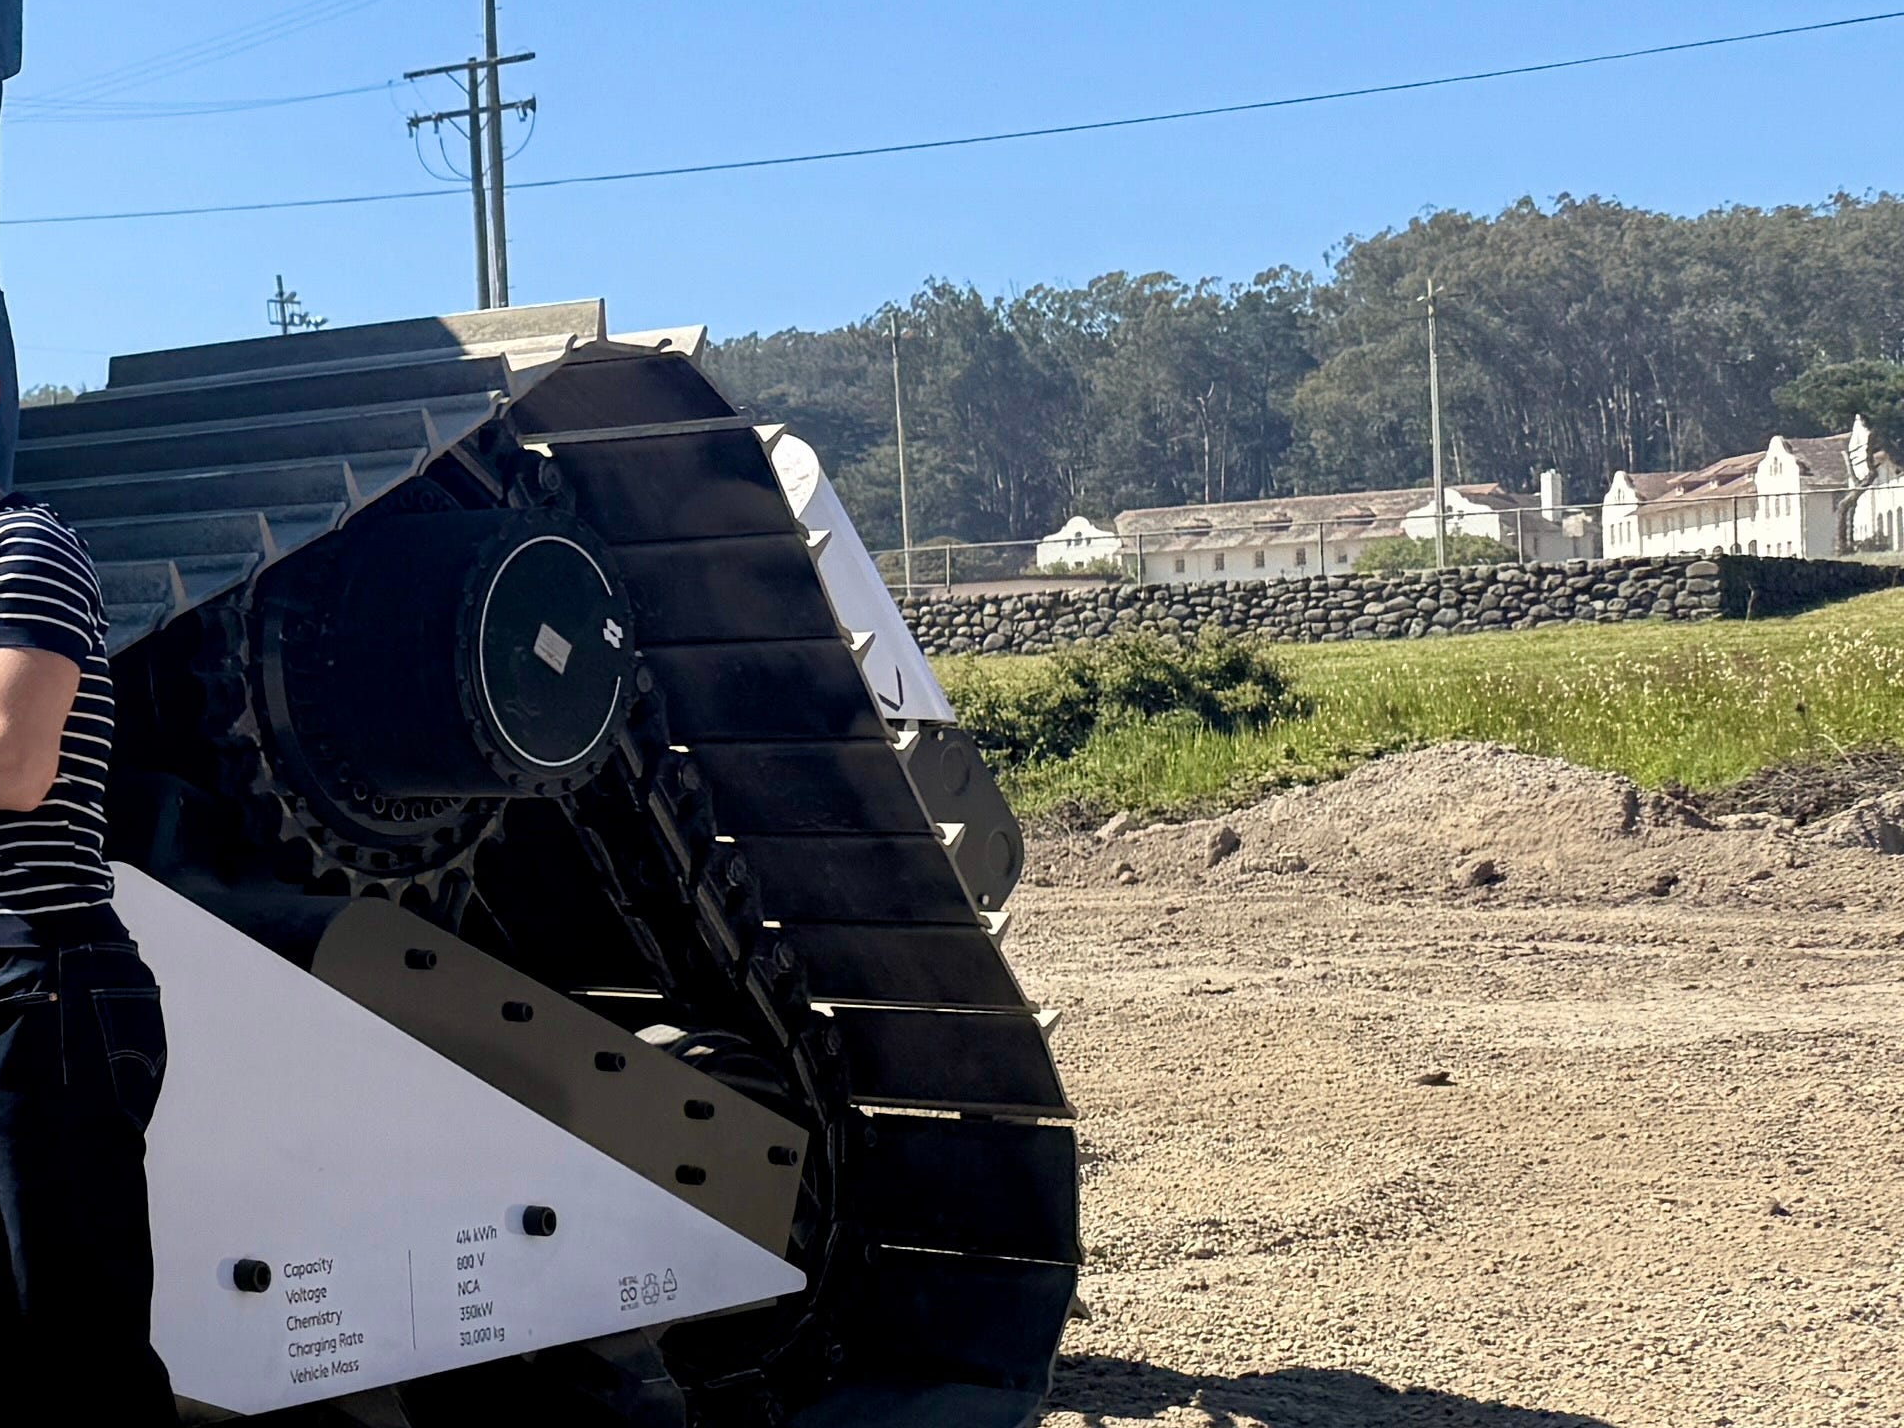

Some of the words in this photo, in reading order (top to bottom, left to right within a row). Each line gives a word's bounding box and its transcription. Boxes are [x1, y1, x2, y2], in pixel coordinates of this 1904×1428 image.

[473, 1225, 497, 1242] kWh
[283, 1257, 334, 1280] Capacity
[477, 1251, 486, 1267] V
[285, 1286, 328, 1305] Voltage
[457, 1278, 481, 1297] NCA
[286, 1309, 343, 1332] Chemistry
[460, 1300, 493, 1322] 350kW
[493, 1325, 505, 1342] kg
[288, 1335, 338, 1358] Charging
[339, 1331, 364, 1348] Rate
[290, 1363, 329, 1384] Vehicle
[331, 1359, 360, 1376] Mass
